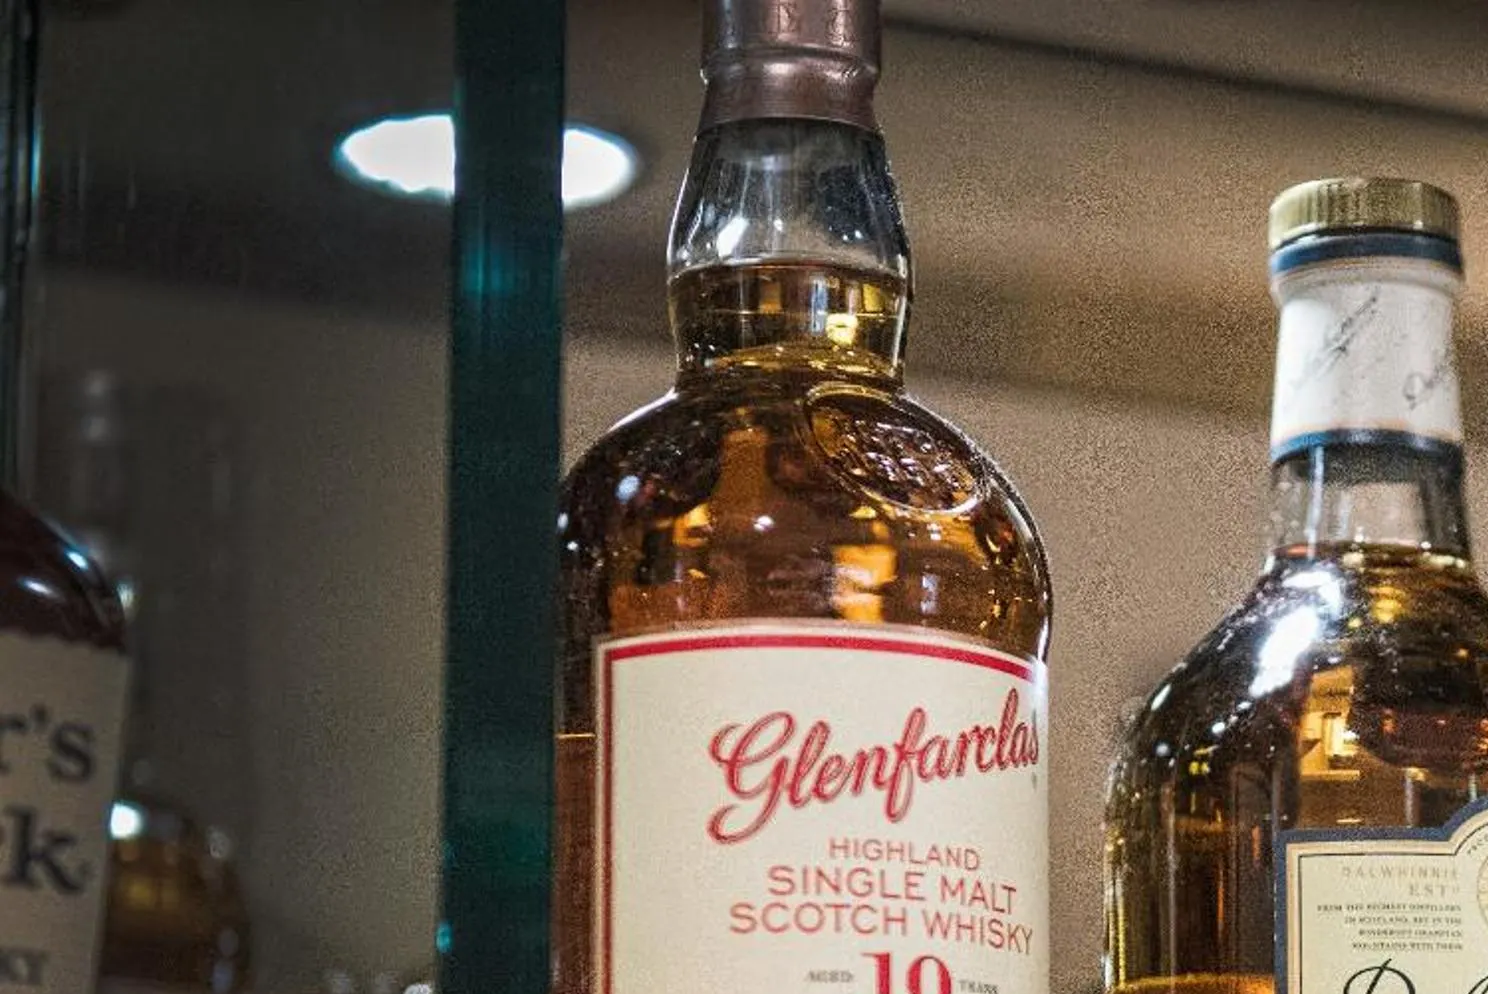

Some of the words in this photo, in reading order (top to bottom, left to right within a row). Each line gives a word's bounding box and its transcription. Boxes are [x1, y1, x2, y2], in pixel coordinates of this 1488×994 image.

[706, 686, 1040, 845] Glenfarclas
[828, 836, 981, 872] HIGHLAND
[767, 865, 926, 902] SINGLE
[938, 873, 1017, 916] MALT
[728, 902, 908, 937] SCOTCH
[921, 905, 1034, 956] WHISKY
